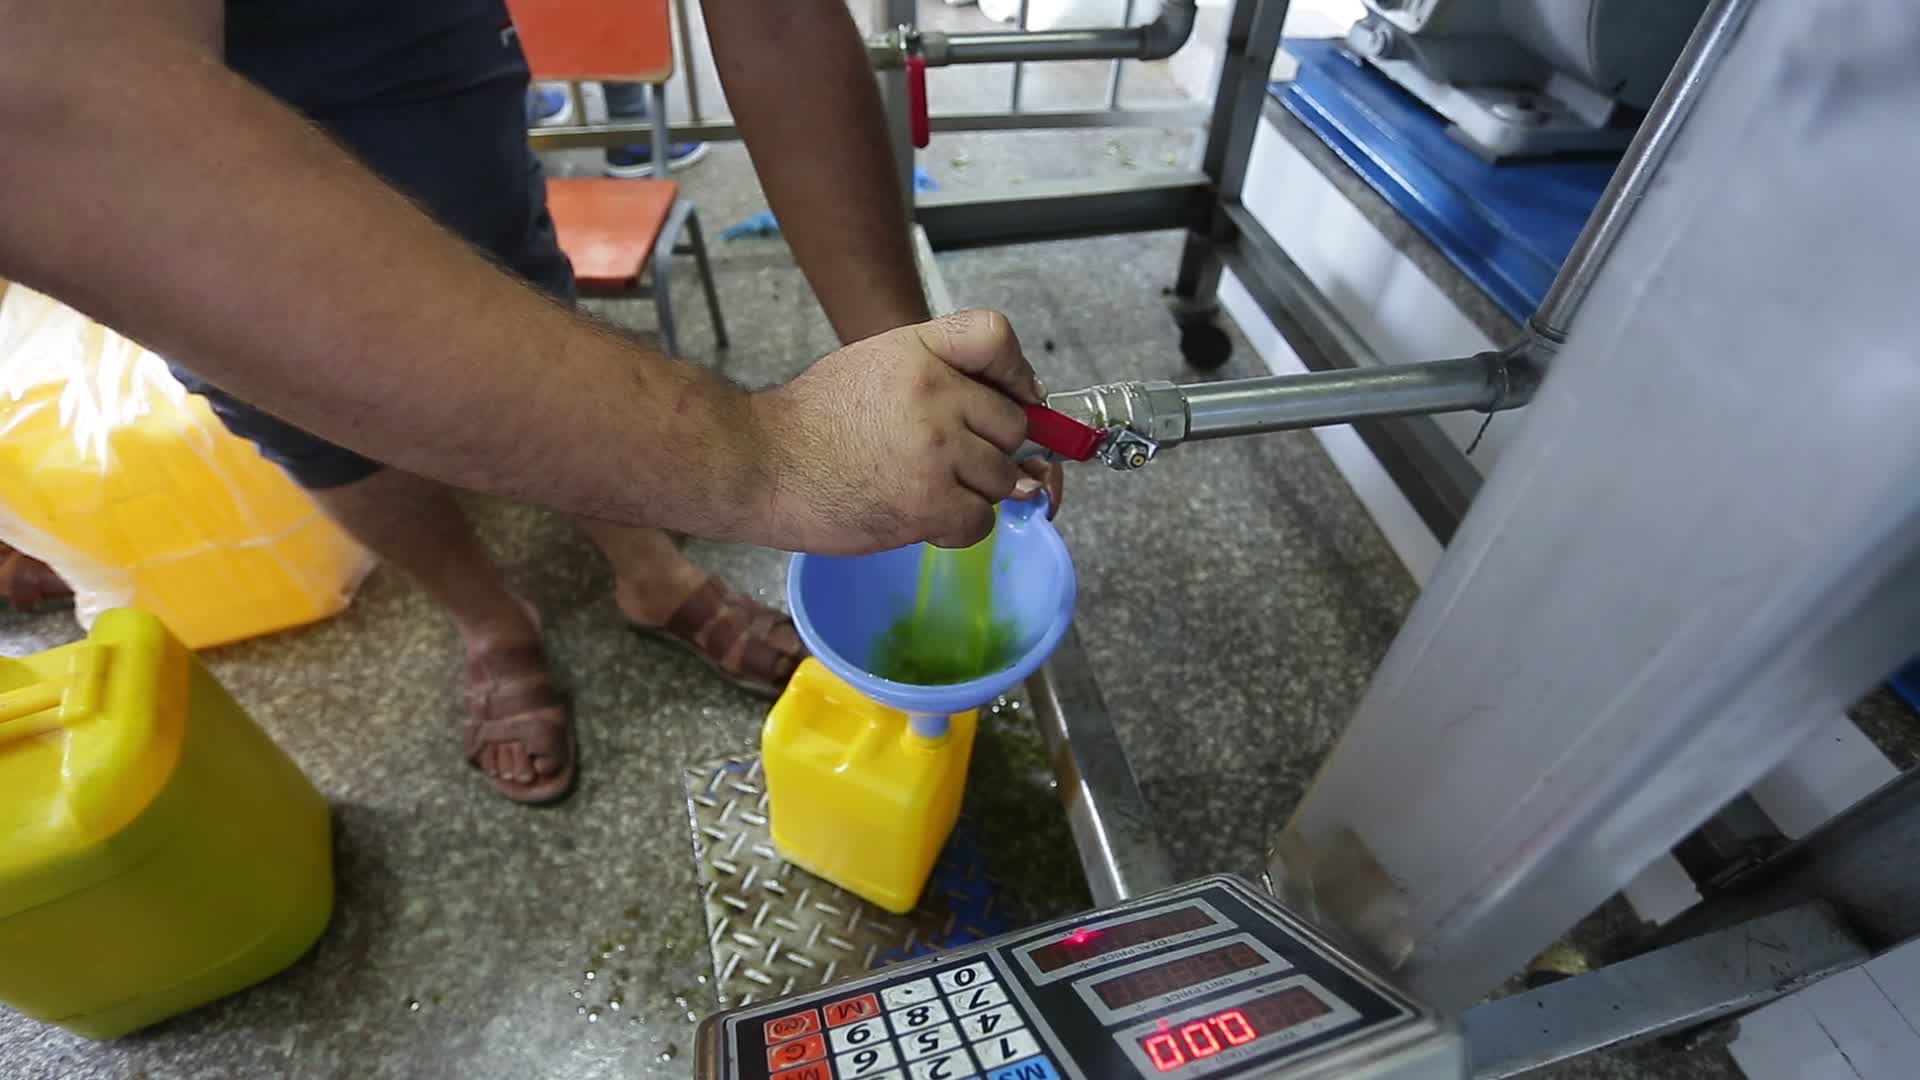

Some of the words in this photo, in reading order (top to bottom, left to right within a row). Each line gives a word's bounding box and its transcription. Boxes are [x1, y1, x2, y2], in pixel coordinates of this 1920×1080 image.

[1097, 948, 1135, 963] PRICE
[953, 967, 976, 987] 0
[838, 1001, 864, 1019] M
[968, 988, 991, 1010] 7
[905, 1005, 930, 1027] 8
[977, 1013, 1001, 1034] 4
[846, 1023, 871, 1045] 9
[917, 1029, 940, 1054] 5
[1144, 1007, 1257, 1073] 0.00
[999, 1037, 1018, 1059] 1
[852, 1049, 879, 1074] 6
[928, 1055, 952, 1080] 2
